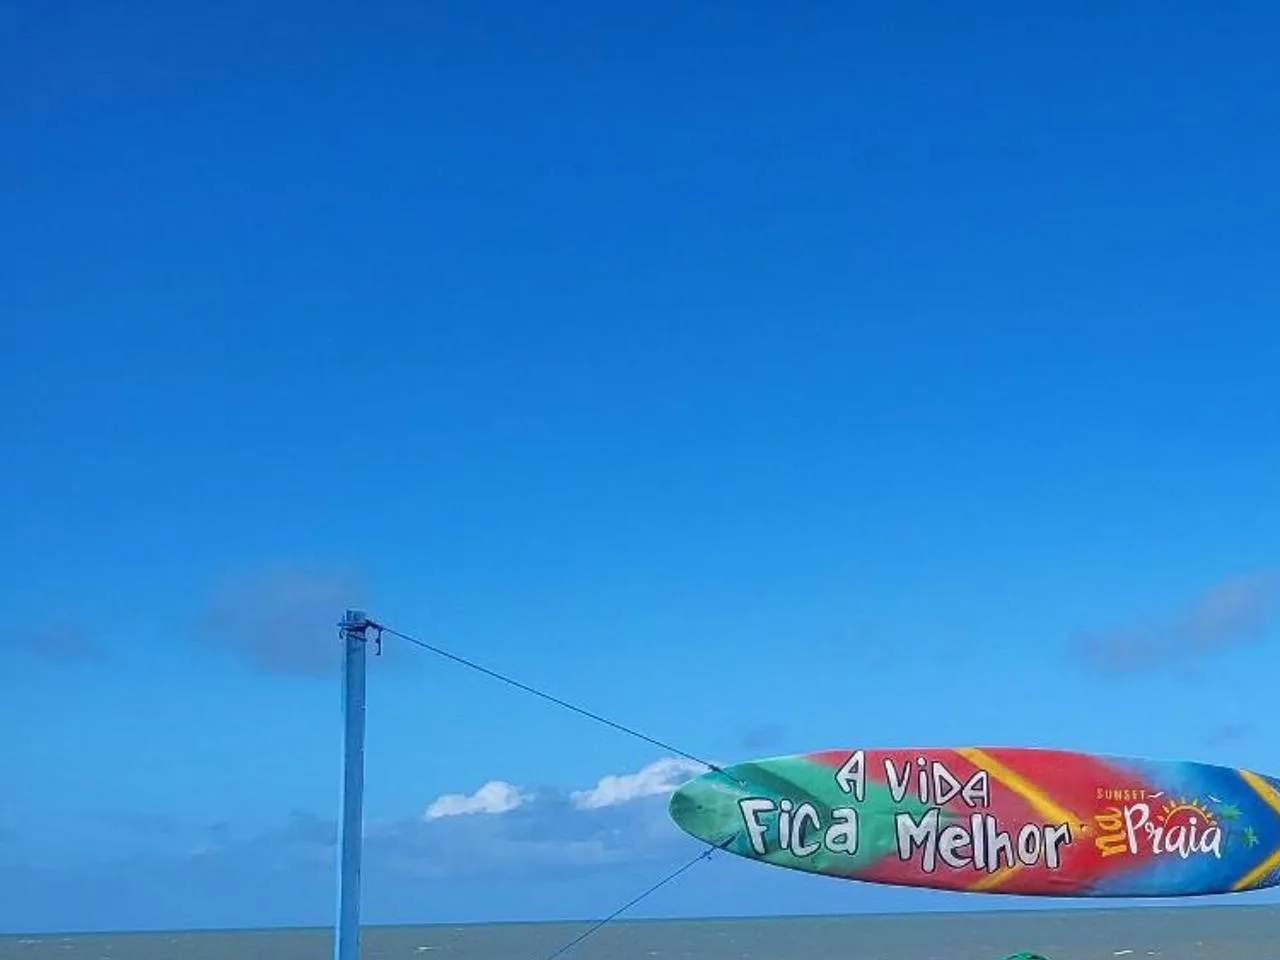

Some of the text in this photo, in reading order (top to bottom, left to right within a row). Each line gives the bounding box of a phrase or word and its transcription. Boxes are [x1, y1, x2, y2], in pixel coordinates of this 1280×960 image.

[835, 750, 866, 801] A
[739, 797, 1072, 873] Fica Melhor
[1124, 803, 1221, 859] Praia
